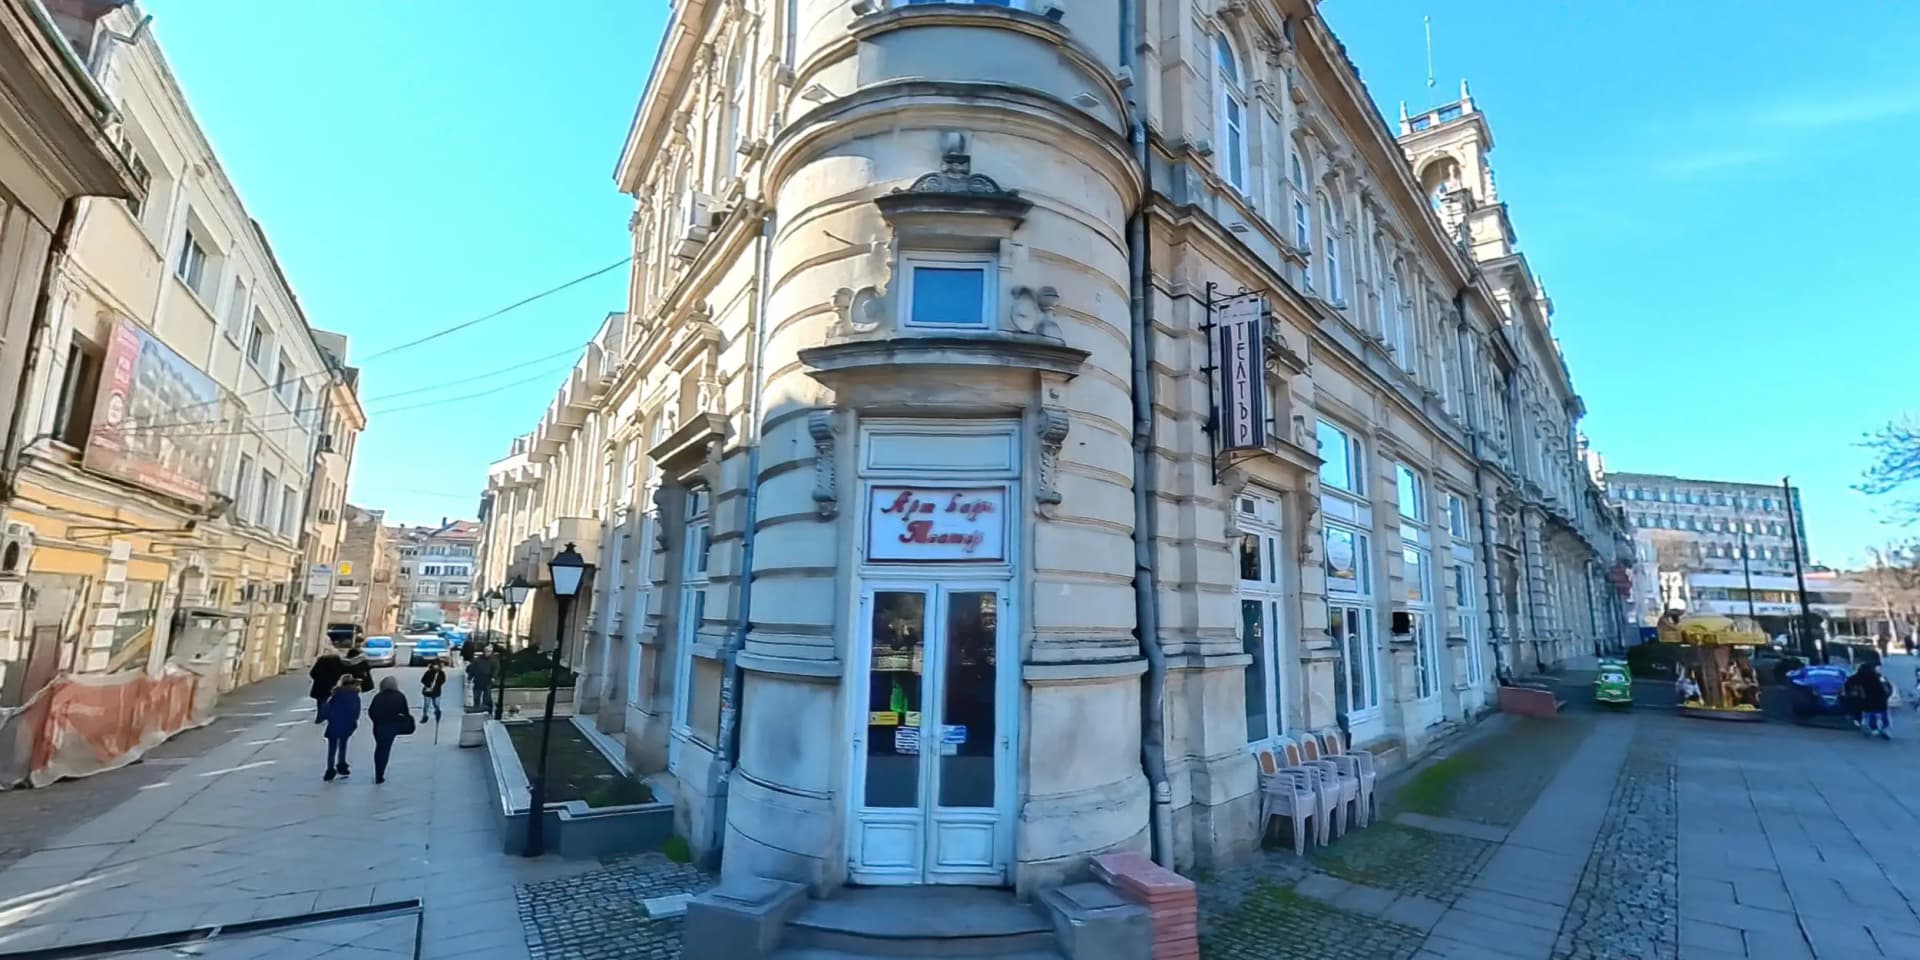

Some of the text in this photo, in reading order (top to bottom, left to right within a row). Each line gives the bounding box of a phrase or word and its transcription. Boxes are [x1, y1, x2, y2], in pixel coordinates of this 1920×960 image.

[1235, 321, 1249, 444] ТЕАТЪР
[881, 490, 936, 522] Арт
[898, 519, 985, 554] Театър
